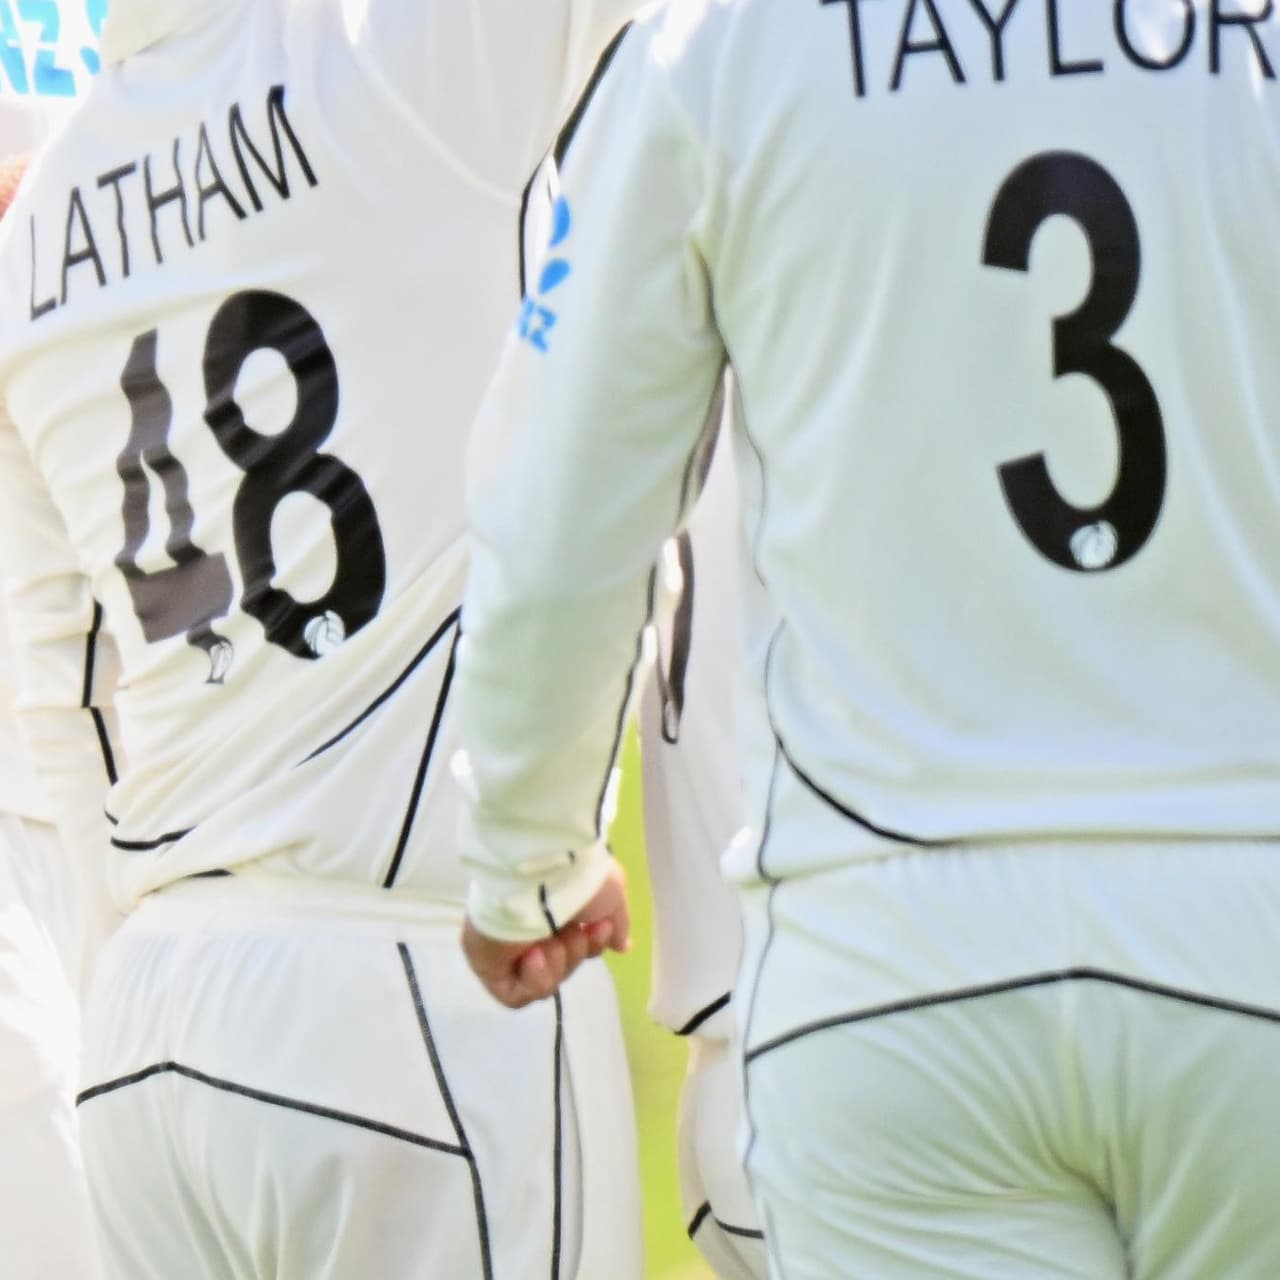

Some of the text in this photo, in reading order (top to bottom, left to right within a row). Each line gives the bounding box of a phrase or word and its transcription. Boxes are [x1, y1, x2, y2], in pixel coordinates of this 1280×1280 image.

[29, 84, 319, 322] LATHAM
[981, 149, 1167, 573] 3
[114, 289, 387, 684] 48
